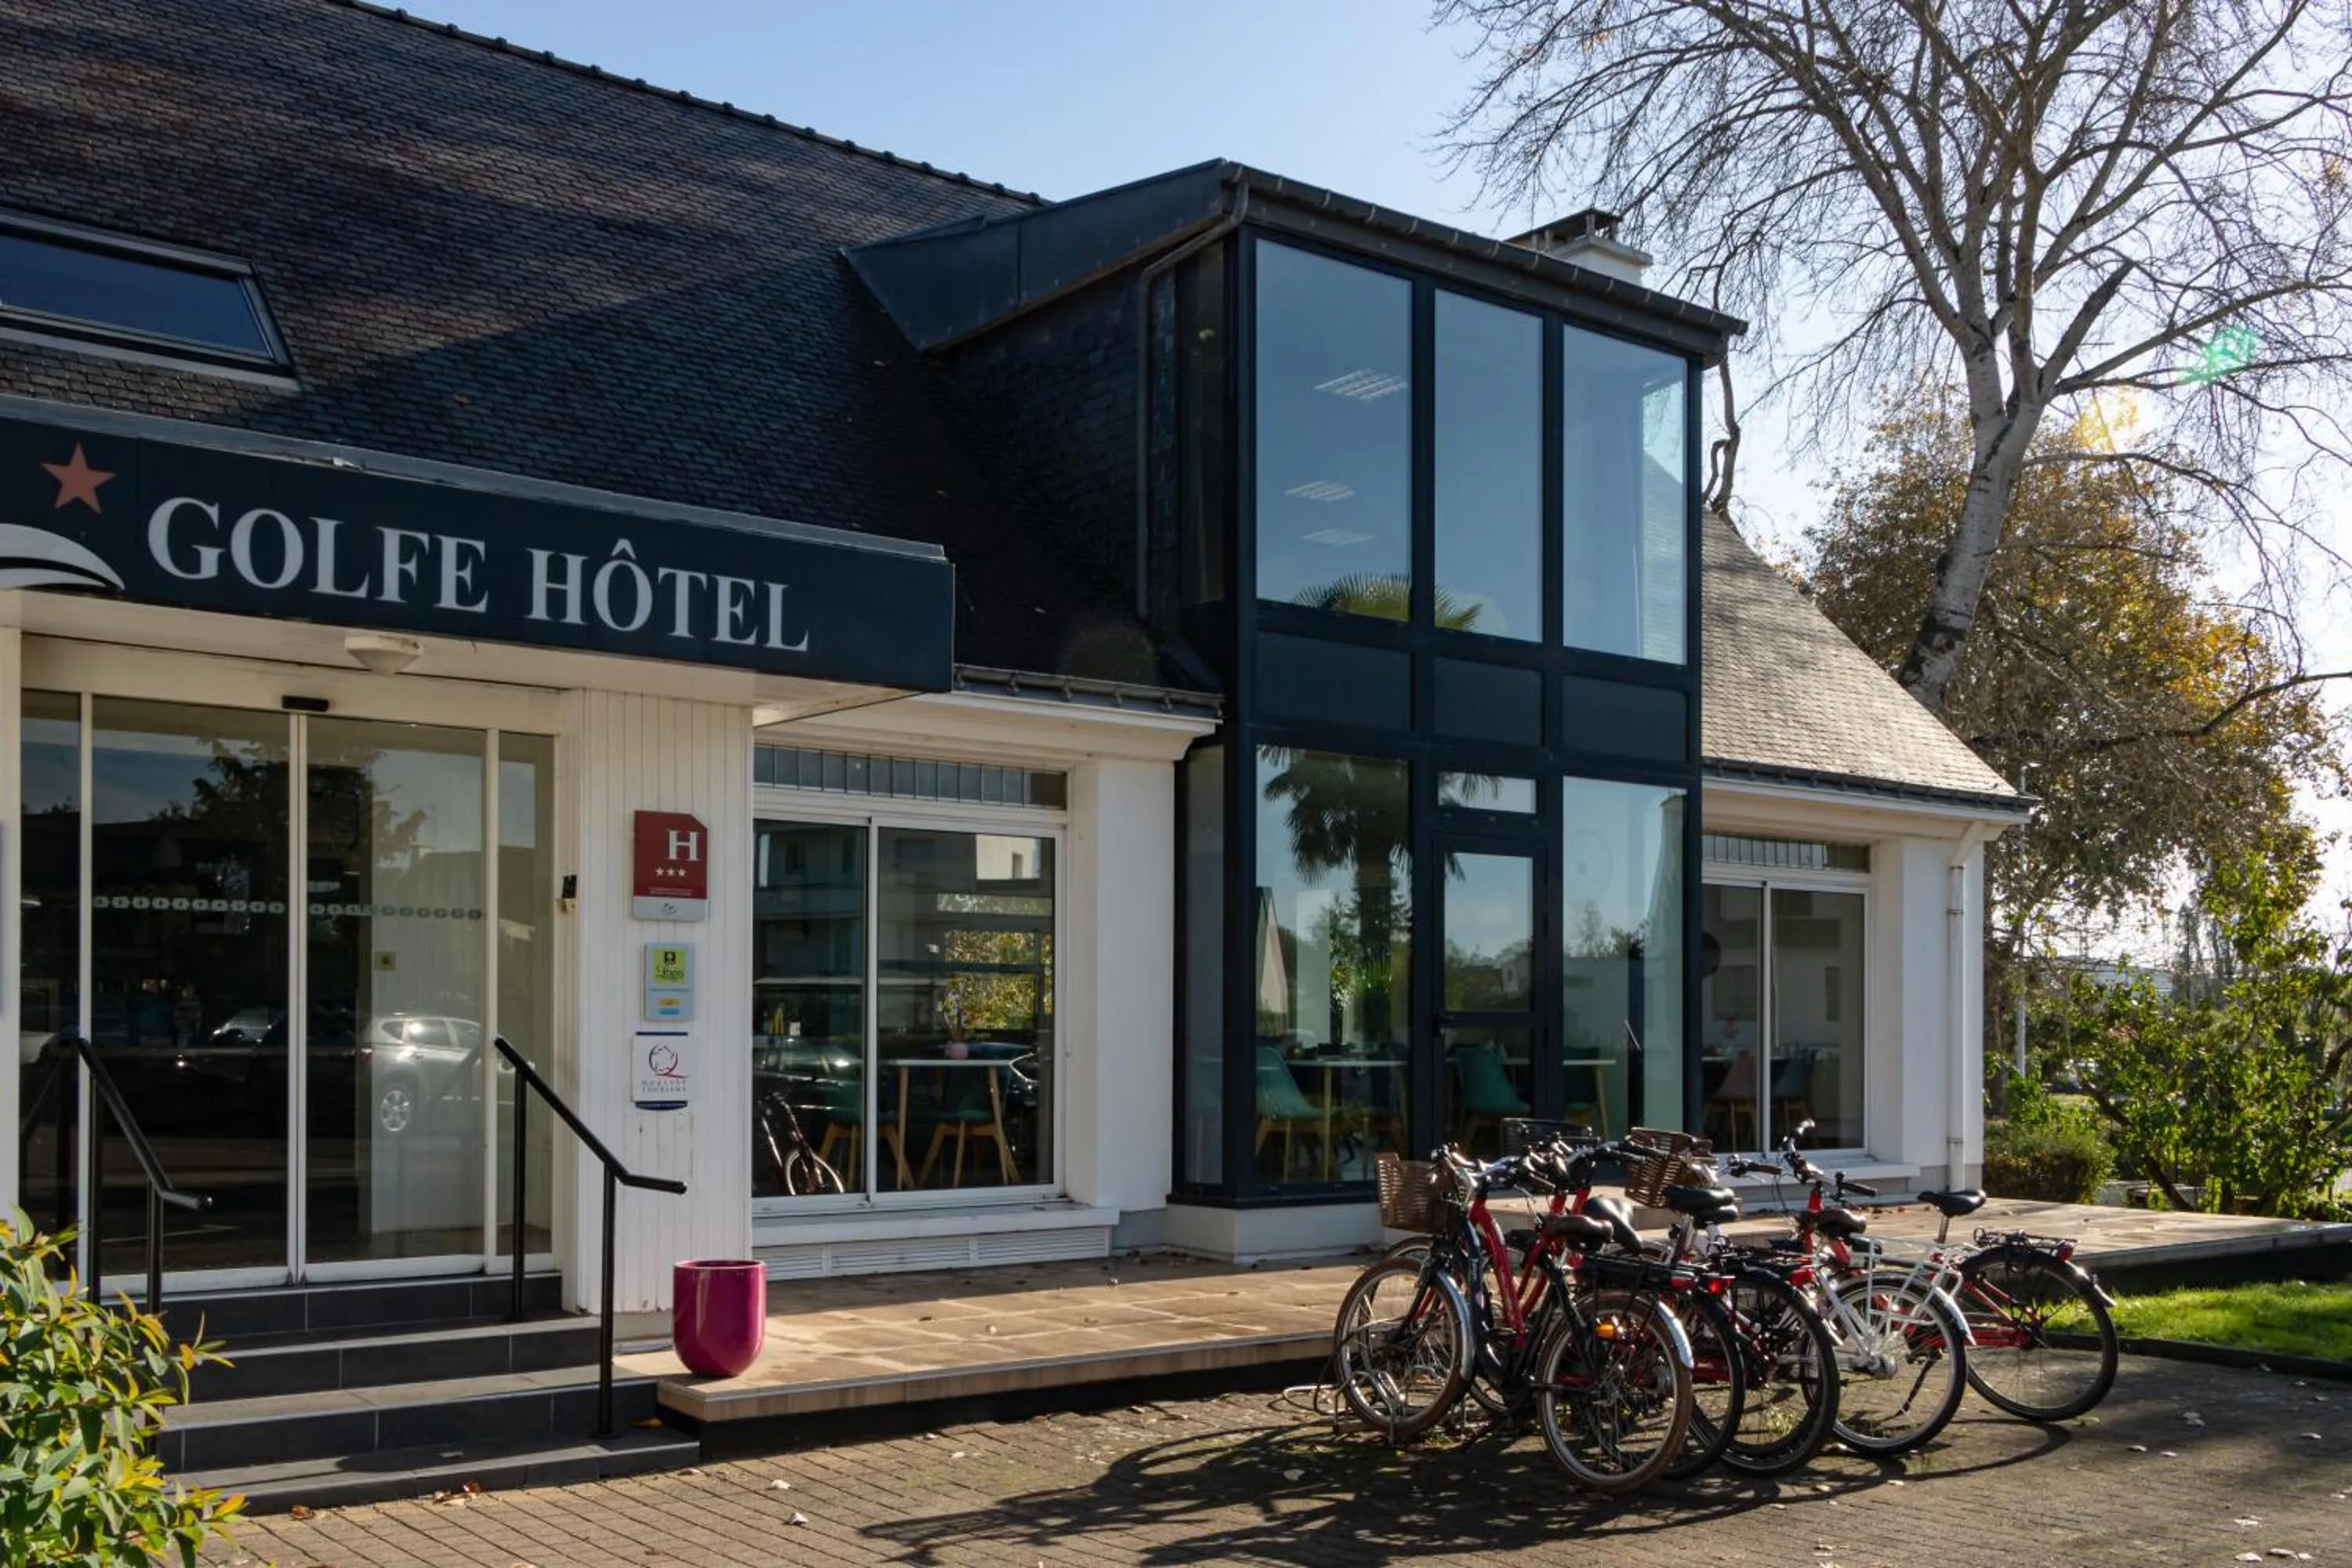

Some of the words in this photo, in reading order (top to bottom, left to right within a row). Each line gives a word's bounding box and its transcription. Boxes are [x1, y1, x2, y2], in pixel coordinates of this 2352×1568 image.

[148, 497, 488, 613] GOLFE
[527, 539, 808, 652] HÔTEL
[665, 829, 700, 862] H
